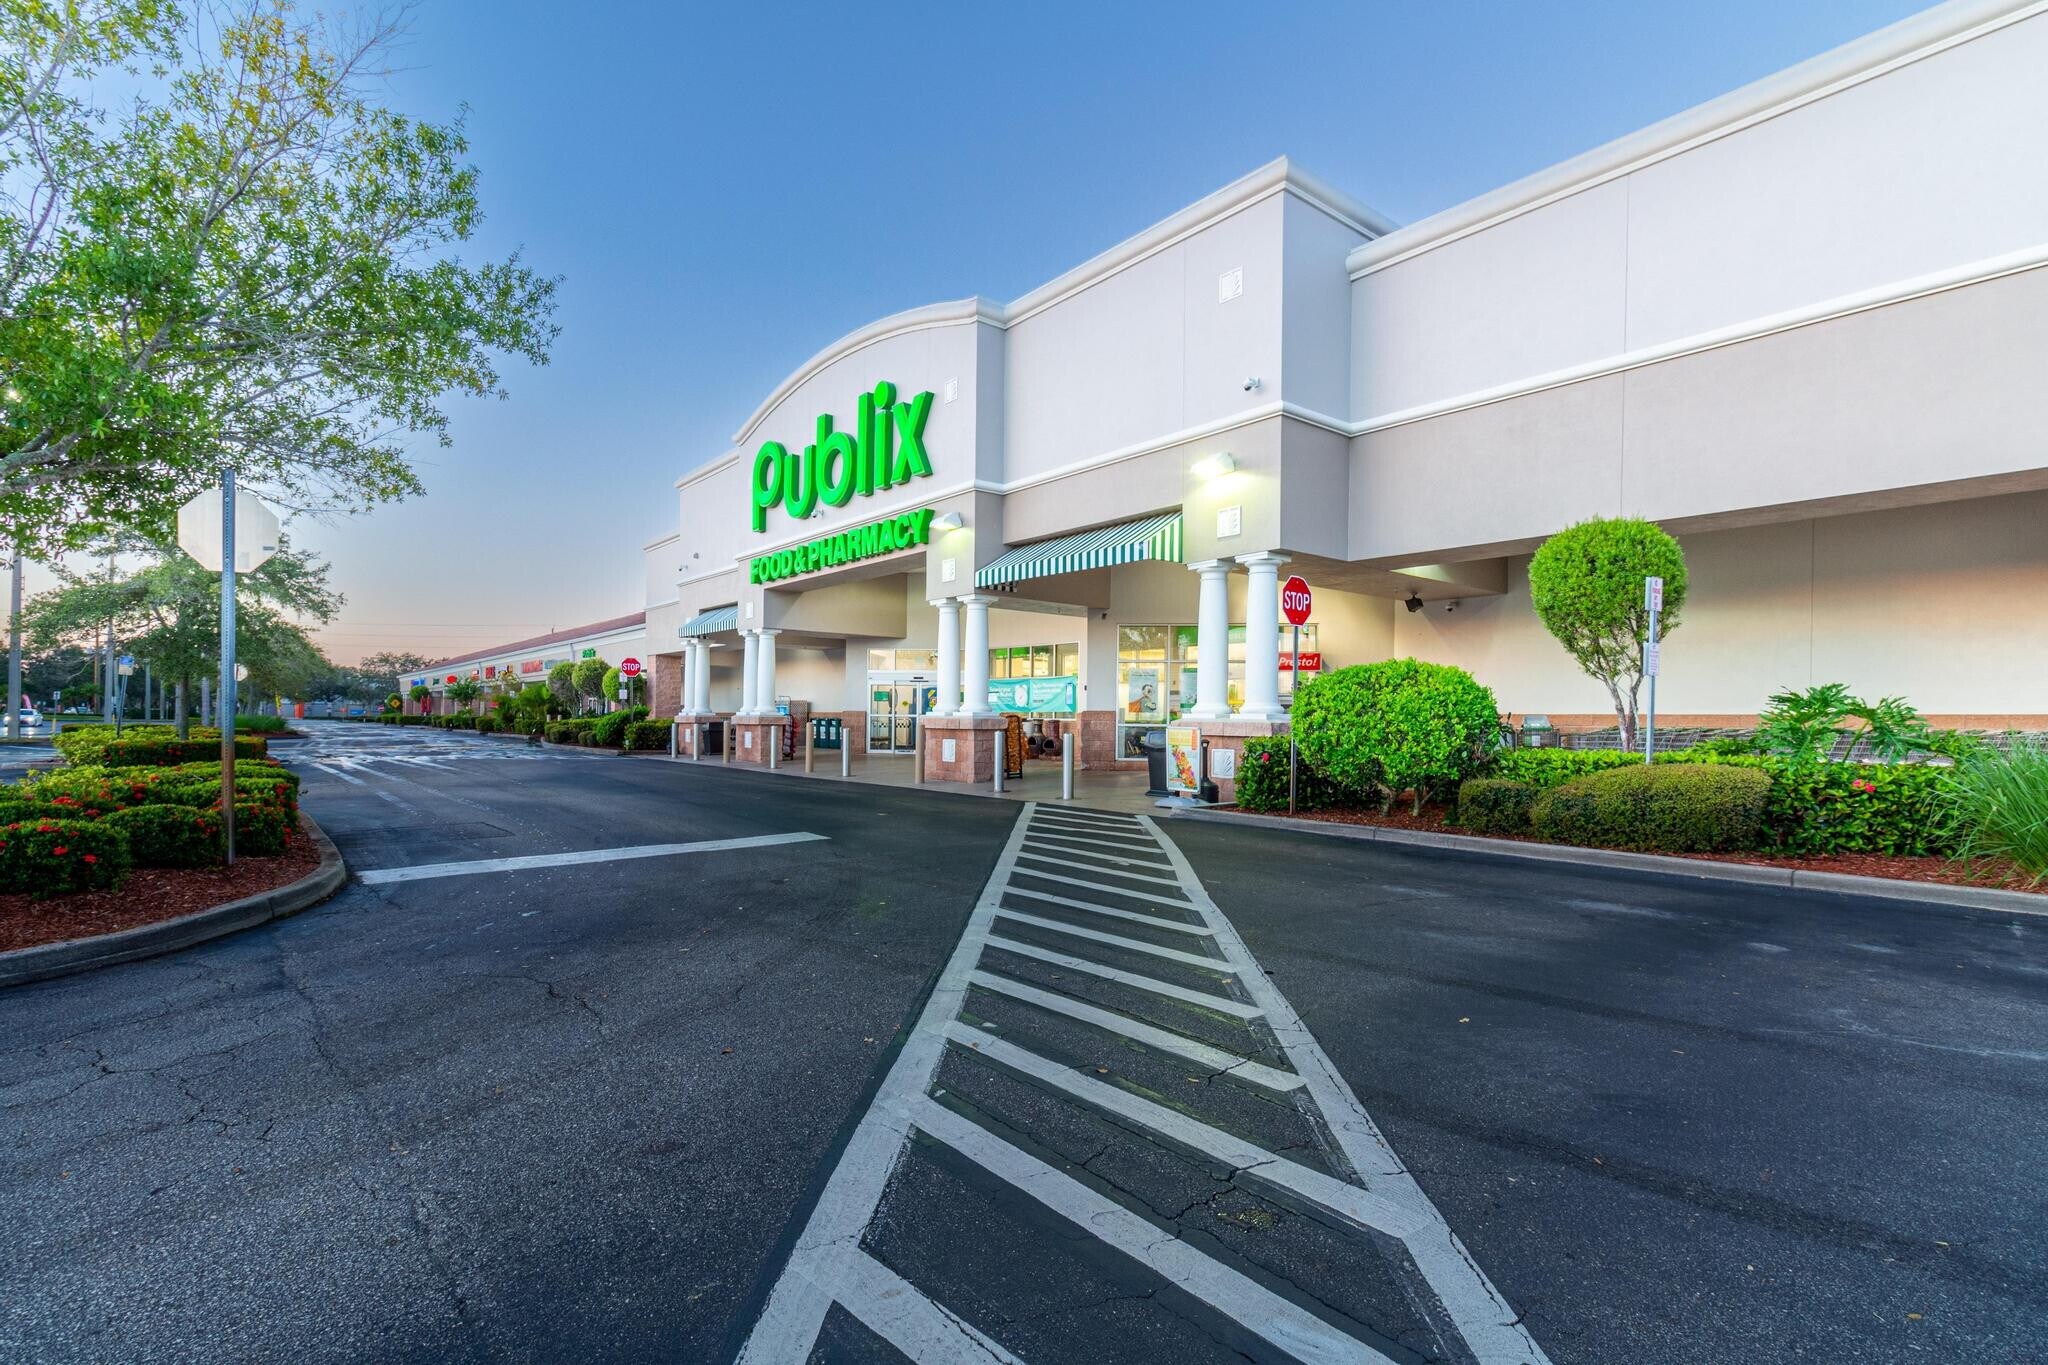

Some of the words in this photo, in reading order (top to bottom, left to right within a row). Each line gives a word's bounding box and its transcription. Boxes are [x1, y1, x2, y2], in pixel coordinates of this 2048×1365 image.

[750, 549, 794, 585] FOOD
[794, 544, 809, 574] &
[808, 508, 935, 571] PHARMACY
[1284, 591, 1310, 611] STOP
[622, 662, 640, 671] STOP
